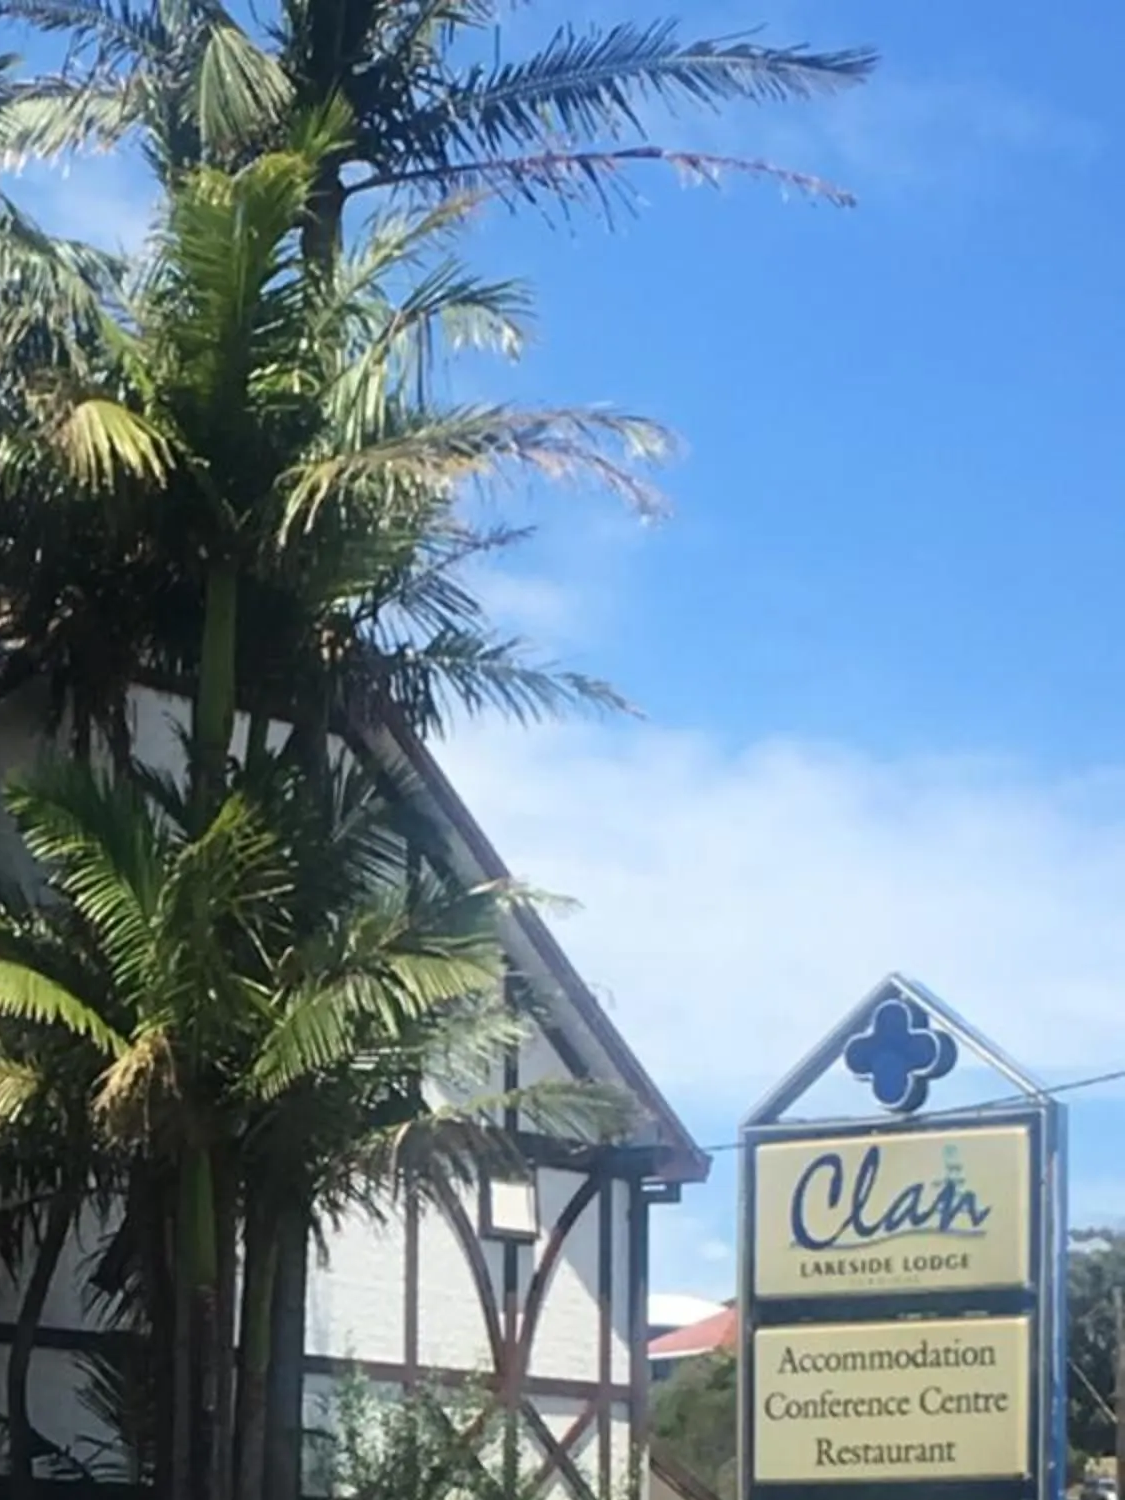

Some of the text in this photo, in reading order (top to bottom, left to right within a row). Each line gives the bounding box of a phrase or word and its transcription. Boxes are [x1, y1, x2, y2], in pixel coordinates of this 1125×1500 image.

[791, 1145, 992, 1250] Clan
[800, 1252, 970, 1278] LAKESIDE LODGE
[778, 1340, 996, 1375] Accommodation
[764, 1386, 1009, 1421] Conference Centre
[815, 1438, 956, 1467] Restaurant
